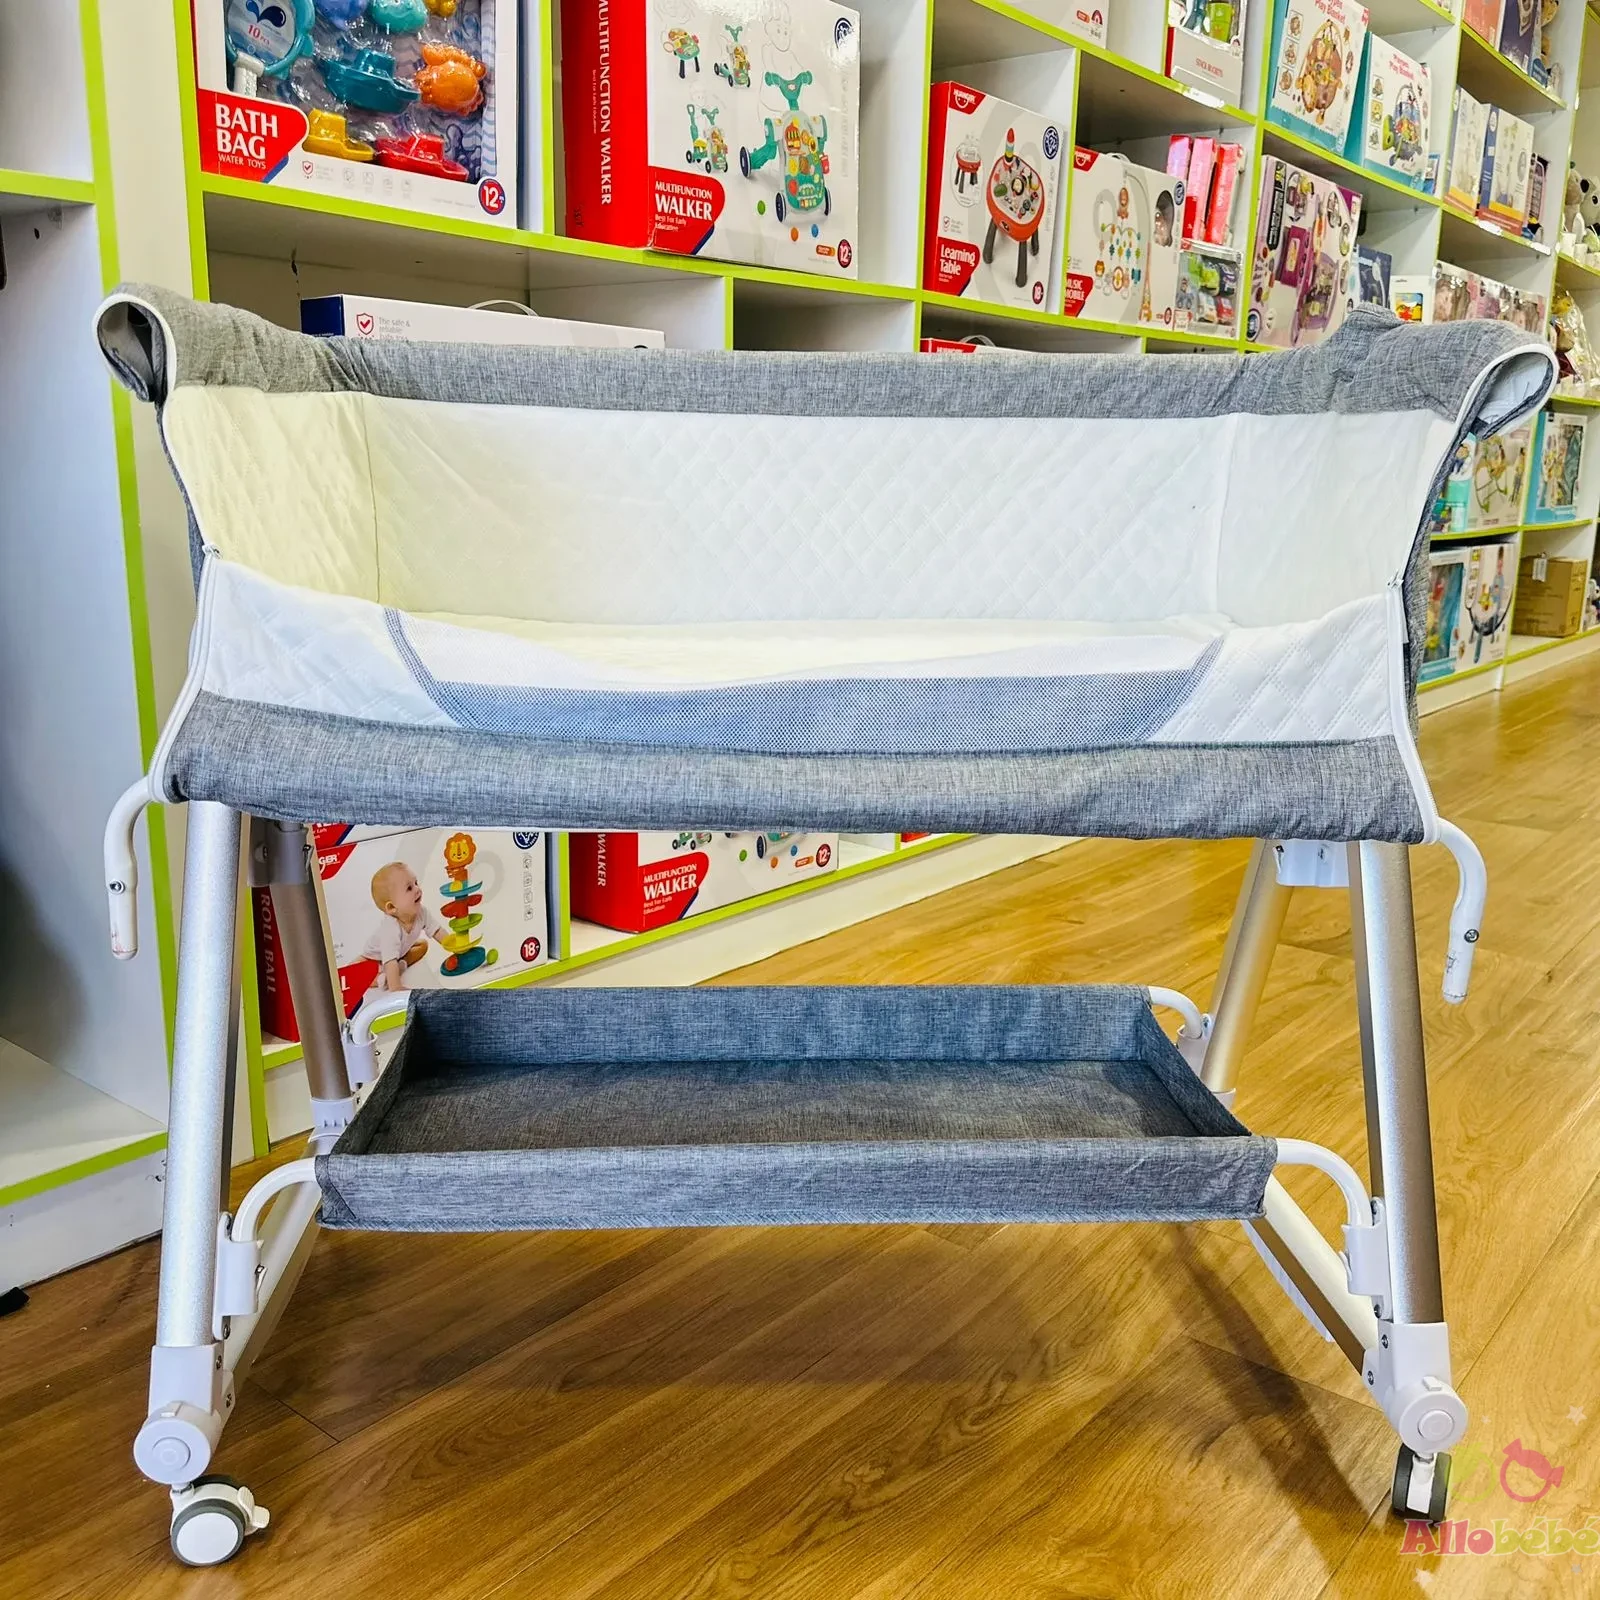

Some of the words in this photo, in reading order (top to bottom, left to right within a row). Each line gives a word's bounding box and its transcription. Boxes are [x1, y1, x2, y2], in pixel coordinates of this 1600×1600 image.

[248, 24, 260, 38] 10
[215, 103, 279, 138] BATH
[216, 128, 266, 160] BAG
[218, 153, 244, 166] WATER
[247, 159, 267, 170] TOYS
[600, 137, 612, 205] WALKER
[655, 181, 713, 200] MULTIFUNCTION
[655, 193, 713, 221] WALKER
[940, 244, 976, 267] Learning
[940, 259, 962, 276] Table
[1066, 289, 1085, 301] OBILE
[1067, 278, 1083, 290] USIC
[597, 833, 607, 887] WALKER
[644, 864, 698, 884] MULTIFUNCTION
[644, 873, 698, 901] WALKER
[261, 893, 273, 941] ROLL
[264, 949, 277, 993] BALL
